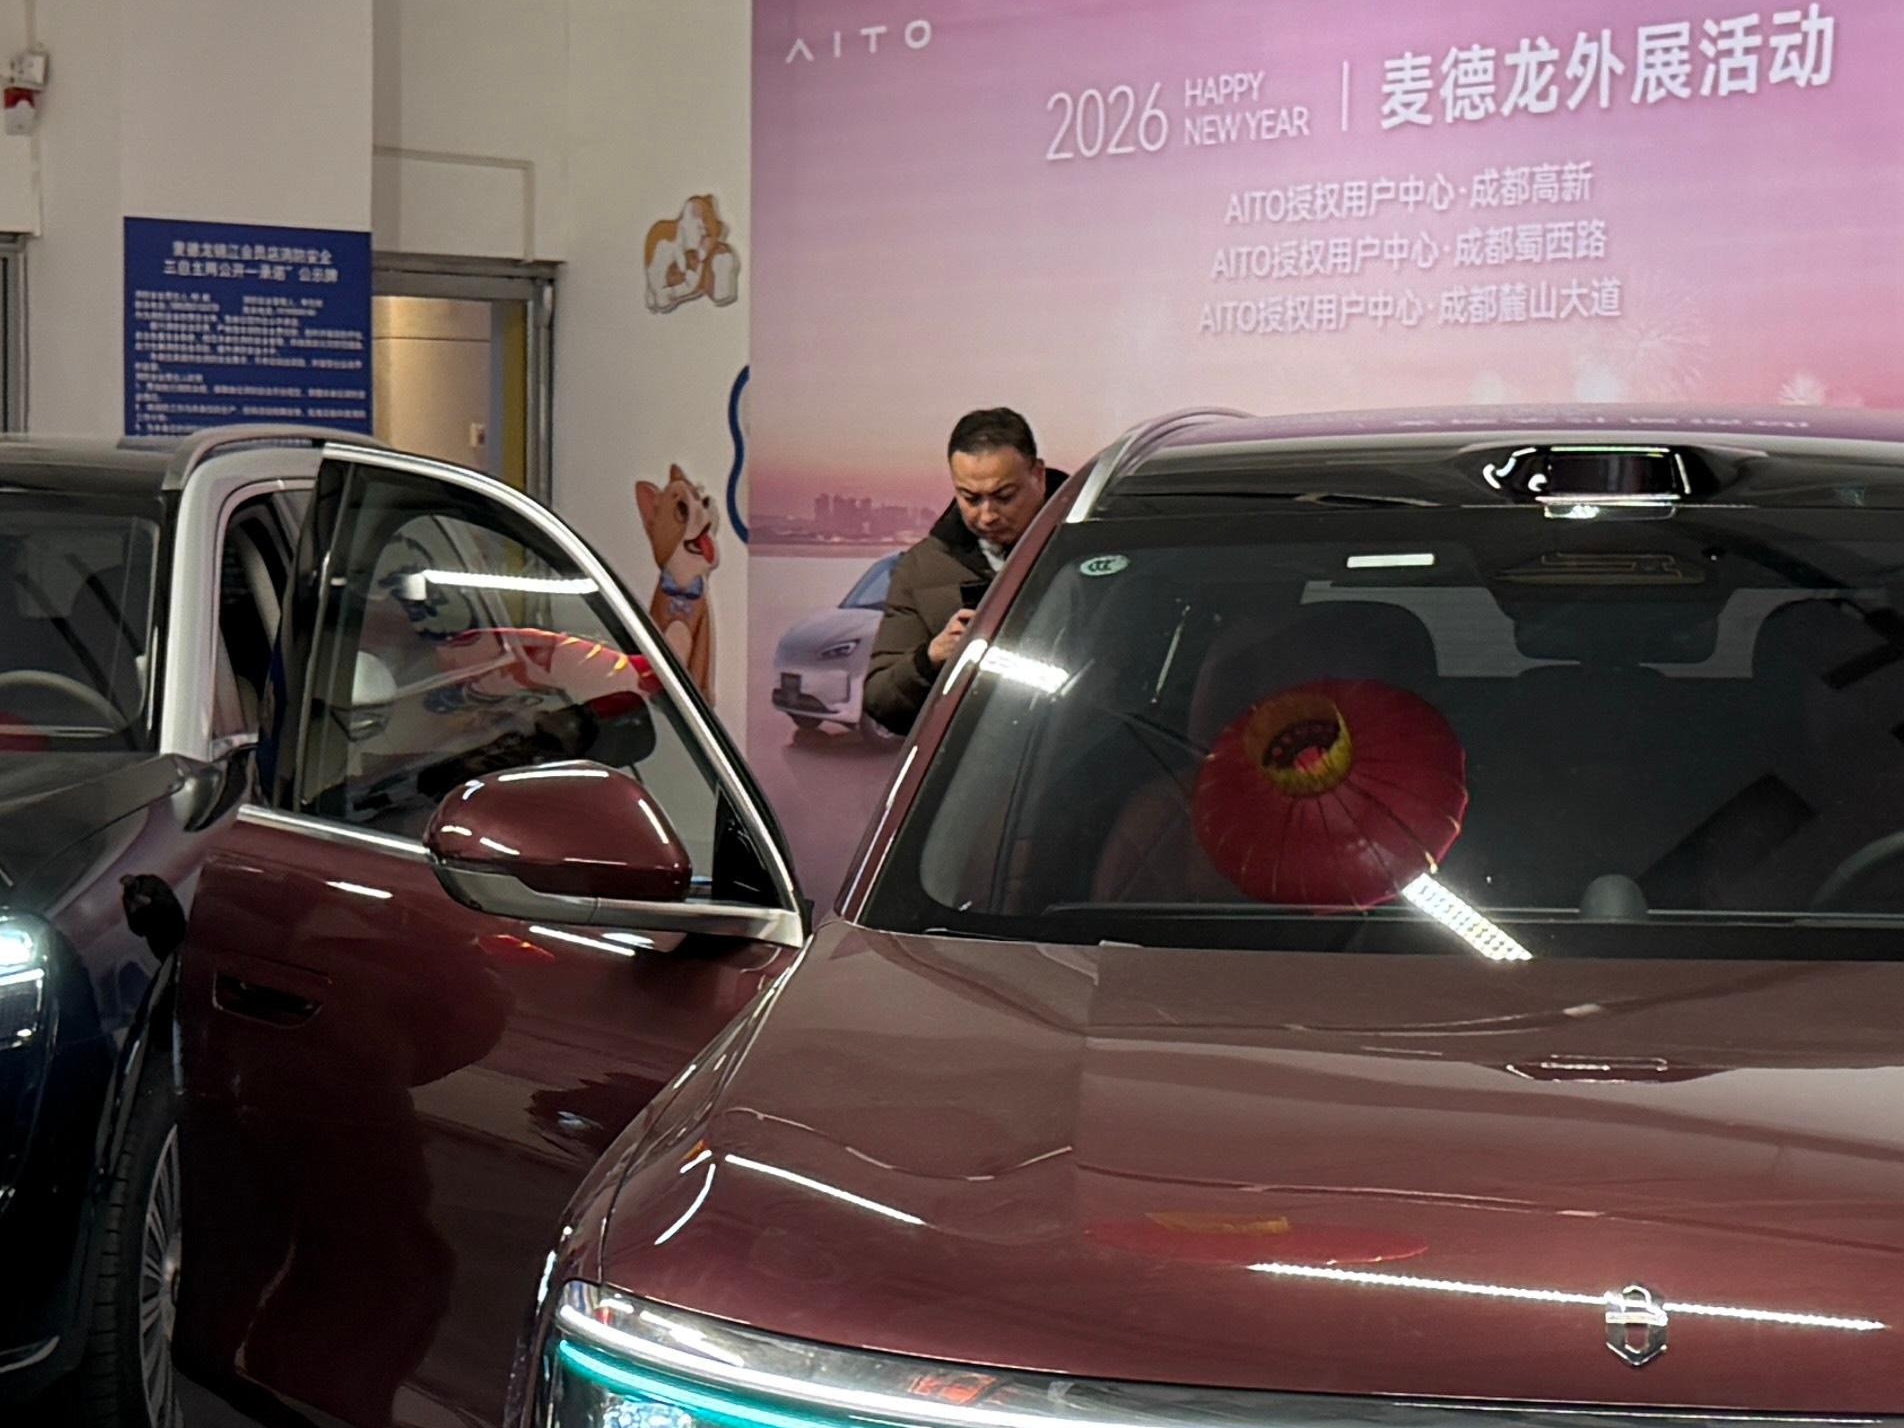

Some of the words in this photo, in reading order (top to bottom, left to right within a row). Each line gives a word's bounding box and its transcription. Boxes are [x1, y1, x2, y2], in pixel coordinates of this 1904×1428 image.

[785, 19, 932, 64] AITO
[1046, 82, 1169, 161] 2026
[1381, 3, 1835, 131] 麦德龙外展活动
[1185, 71, 1266, 108] HAPPY
[1185, 113, 1242, 147] NEW
[1246, 107, 1309, 141] YEAR
[1224, 161, 1593, 226] AITO授权用户中心·成都高新
[1211, 219, 1607, 282] AITO授权用户中心·成都蜀西路
[1199, 278, 1622, 337] AITO授权用户中心·成都麓山大道
